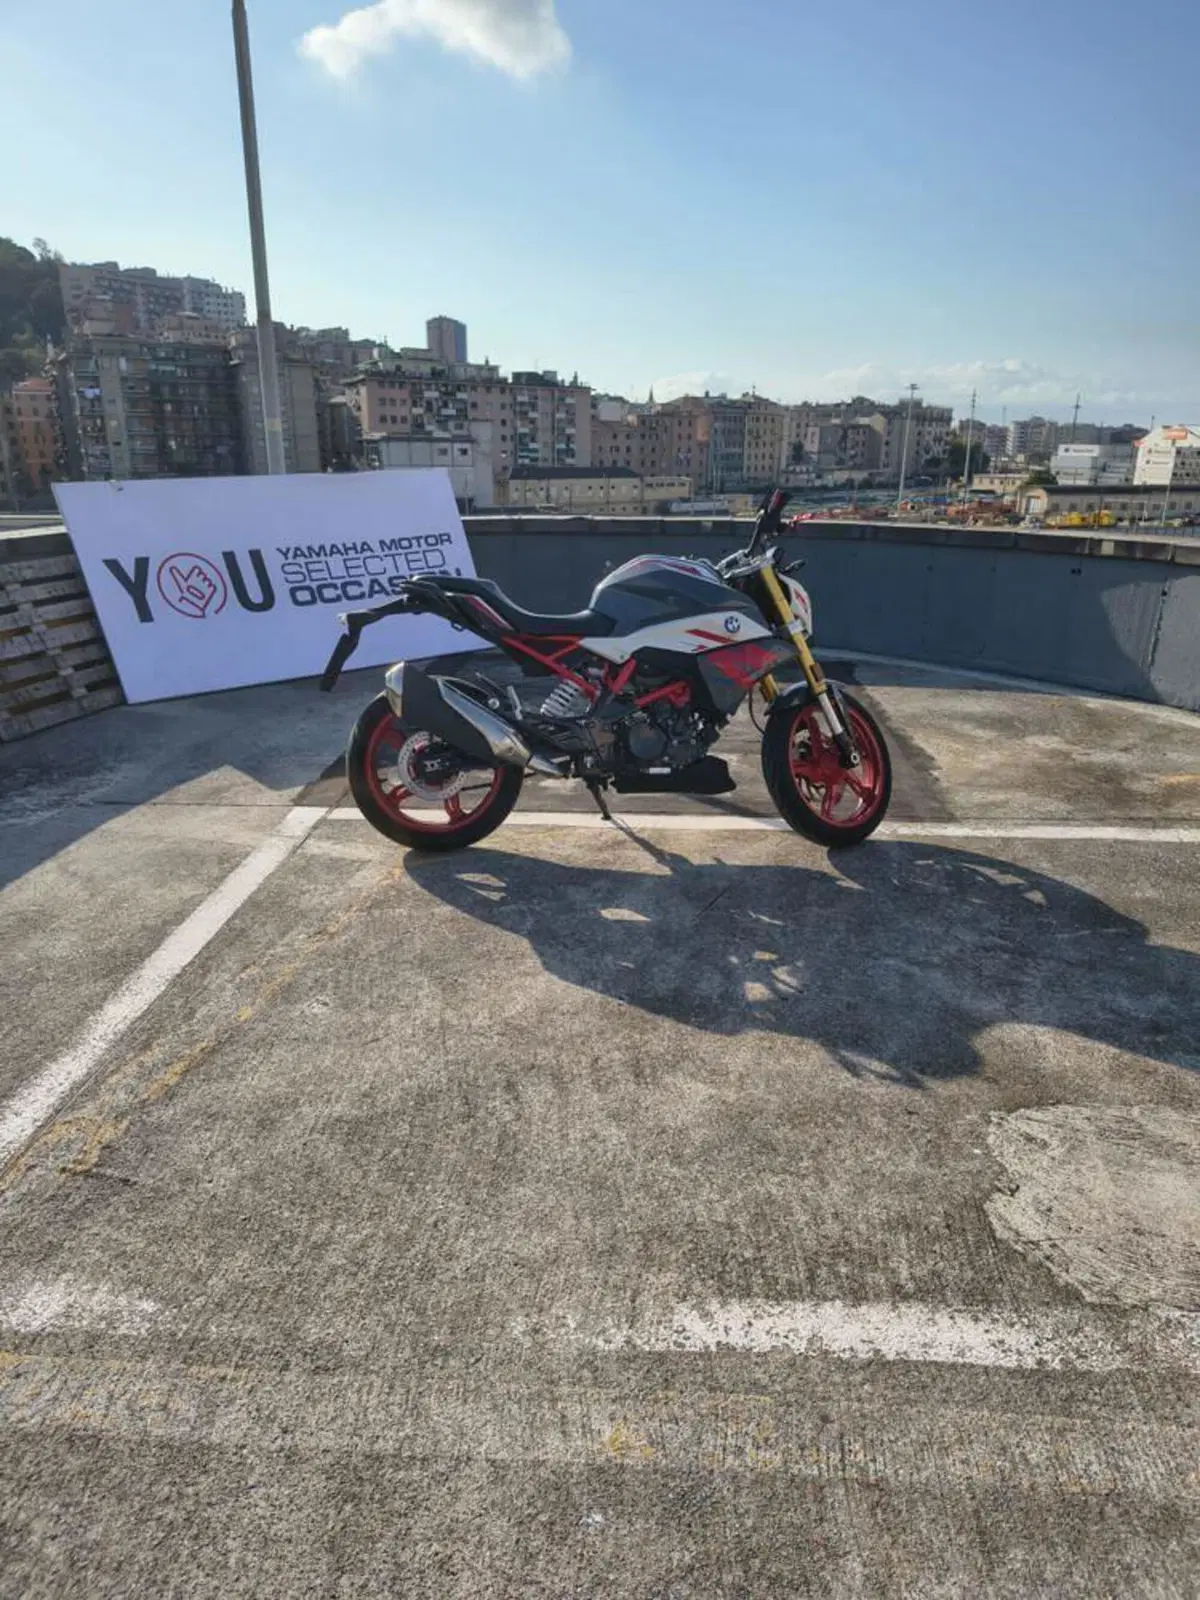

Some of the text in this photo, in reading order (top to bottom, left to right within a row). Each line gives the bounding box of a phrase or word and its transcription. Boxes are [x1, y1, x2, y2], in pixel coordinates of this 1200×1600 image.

[276, 532, 453, 561] YAMAHA MOTOR
[281, 548, 446, 585] SELECTED
[289, 567, 461, 607] OCCAS
